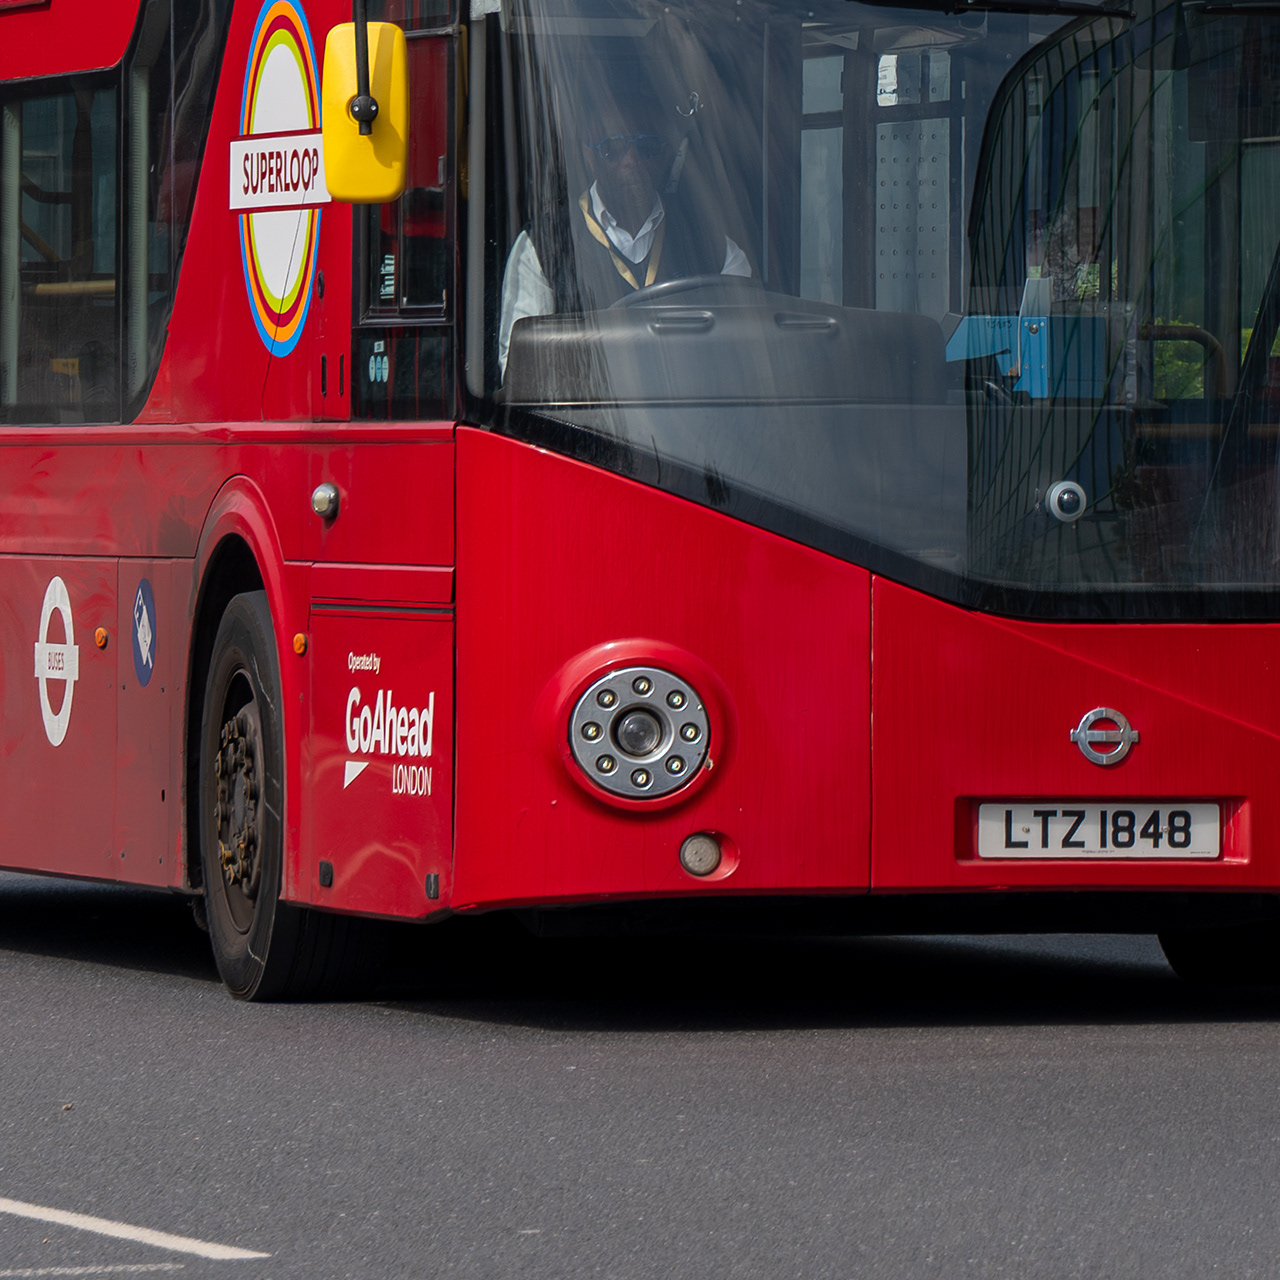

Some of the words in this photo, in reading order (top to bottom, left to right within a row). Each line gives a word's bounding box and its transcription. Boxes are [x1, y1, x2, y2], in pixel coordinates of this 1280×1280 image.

[243, 148, 319, 195] SUPERLOOP
[48, 652, 64, 670] BUSES
[348, 651, 373, 673] Operated
[373, 653, 381, 674] by
[345, 686, 435, 757] GoAhead
[392, 764, 433, 796] LONDON
[1004, 810, 1086, 848] LTZ
[1099, 810, 1191, 848] 1848
